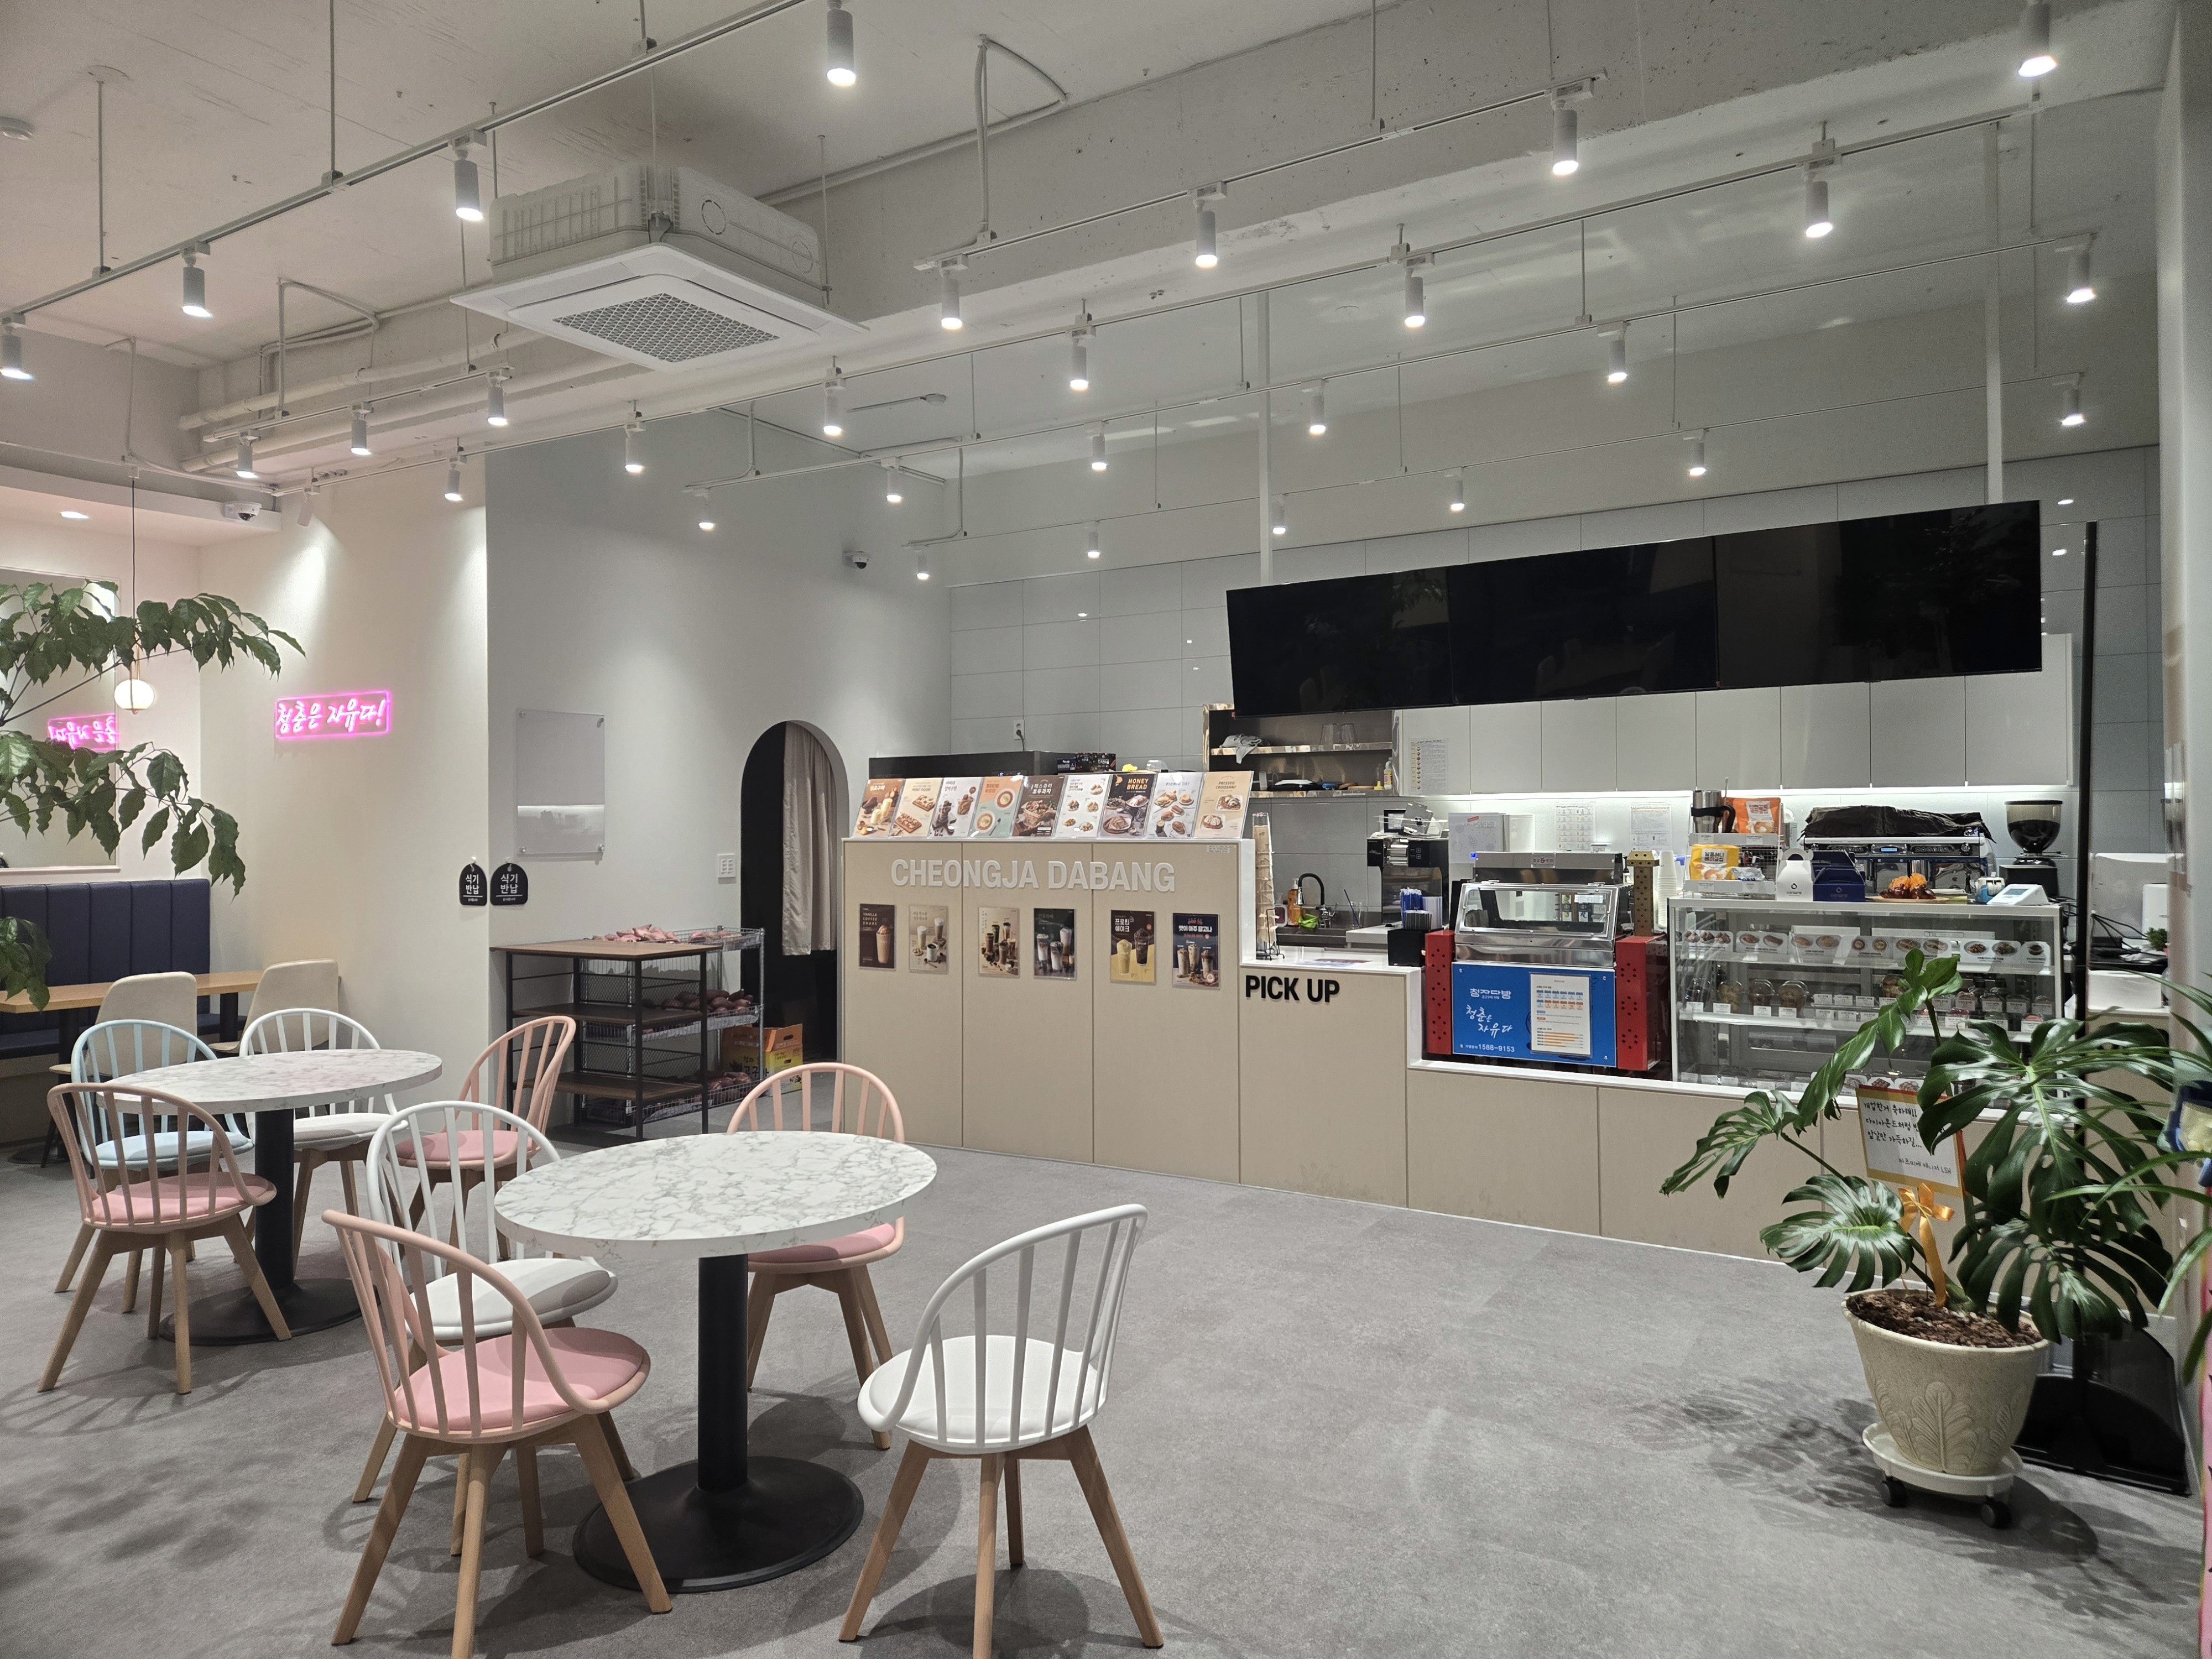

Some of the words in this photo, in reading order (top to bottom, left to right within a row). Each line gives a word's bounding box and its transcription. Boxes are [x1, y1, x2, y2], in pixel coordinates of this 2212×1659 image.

[276, 700, 323, 734] 청춘은
[327, 698, 386, 733] 자유다!
[466, 874, 479, 884] 식기
[500, 873, 518, 883] 식기
[891, 859, 1040, 889] CHEONGJA
[1048, 861, 1176, 892] DABANG
[466, 884, 479, 894] 반납
[500, 884, 518, 894] 반납
[1245, 975, 1300, 1001] PICK
[1307, 978, 1340, 1003] UP
[1470, 988, 1512, 999] 청자다방
[1466, 1004, 1492, 1022] 청춘은
[1478, 1022, 1513, 1039] 자유다
[1478, 1044, 1515, 1052] 1588-9153
[1892, 1104, 1917, 1117] 축하해!!
[1867, 1129, 1886, 1141] 앞날만
